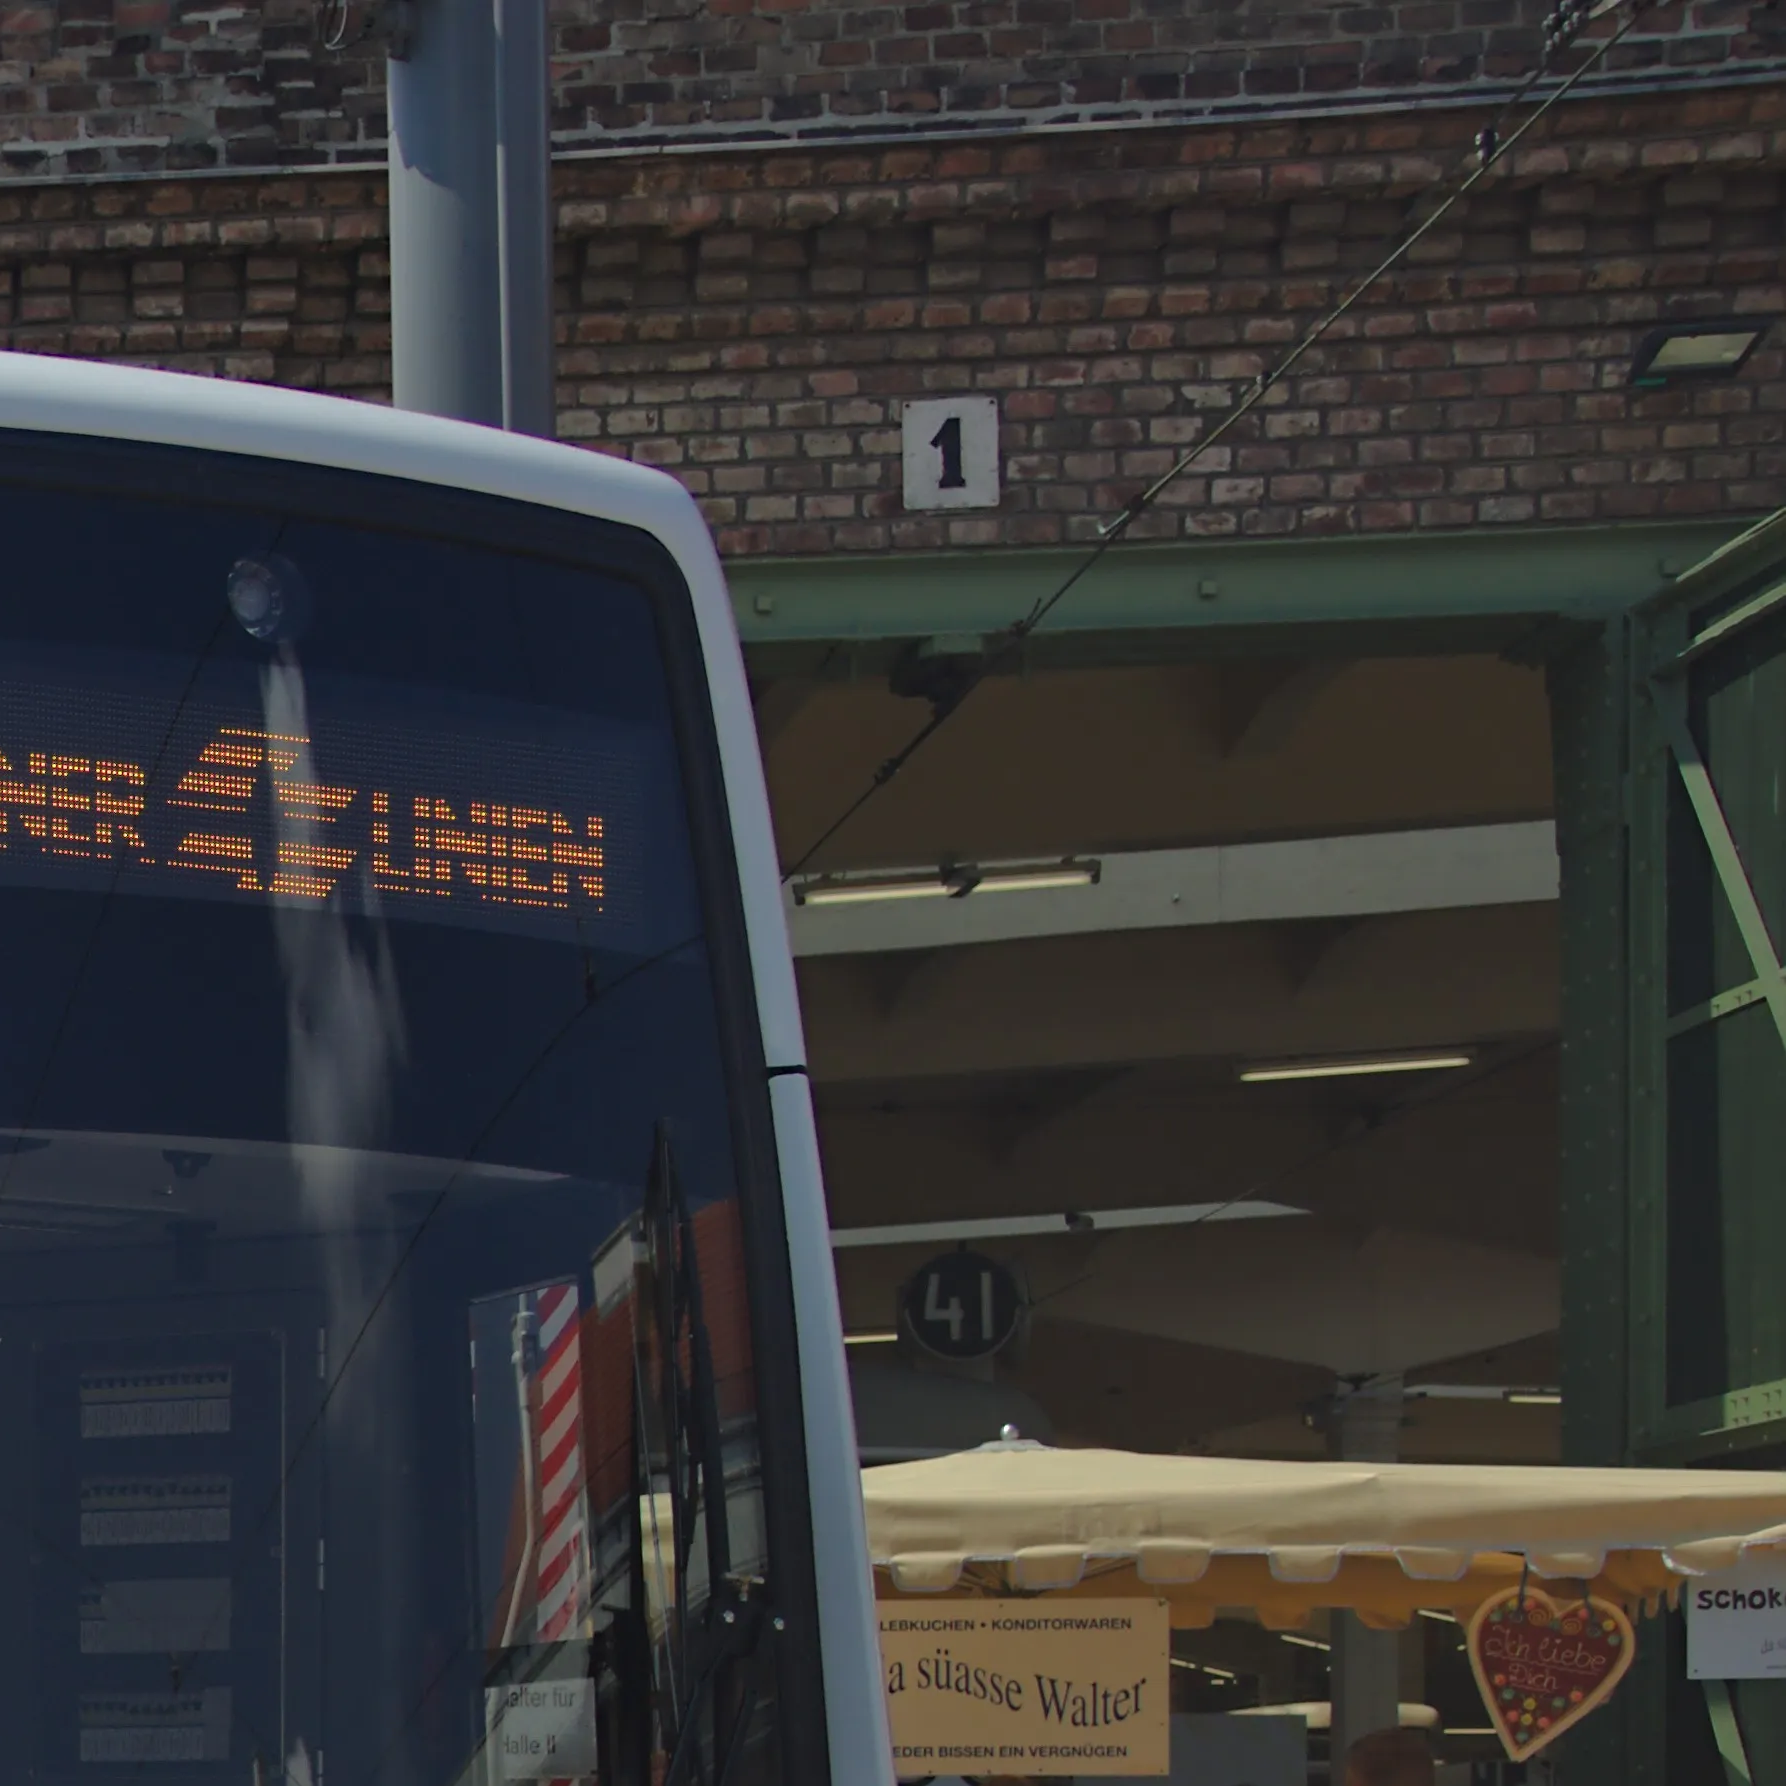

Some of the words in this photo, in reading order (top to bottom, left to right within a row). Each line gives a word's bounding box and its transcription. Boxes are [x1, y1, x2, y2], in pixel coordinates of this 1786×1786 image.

[929, 416, 966, 489] 1
[923, 1270, 995, 1342] 41
[878, 1618, 976, 1633] LEBKUCHEN
[991, 1616, 1133, 1632] KONDITORWAREN
[1484, 1624, 1531, 1659] Ich
[1538, 1636, 1606, 1671] liebe
[886, 1658, 907, 1696] a
[916, 1647, 1024, 1712] süasse
[1033, 1671, 1148, 1728] Walter
[1509, 1663, 1559, 1690] Dich
[507, 1685, 548, 1708] alter
[891, 1745, 934, 1758] EDER
[938, 1745, 994, 1758] BISSEN
[998, 1745, 1024, 1758] EIN
[1028, 1742, 1128, 1758] VERGNÜGEN
